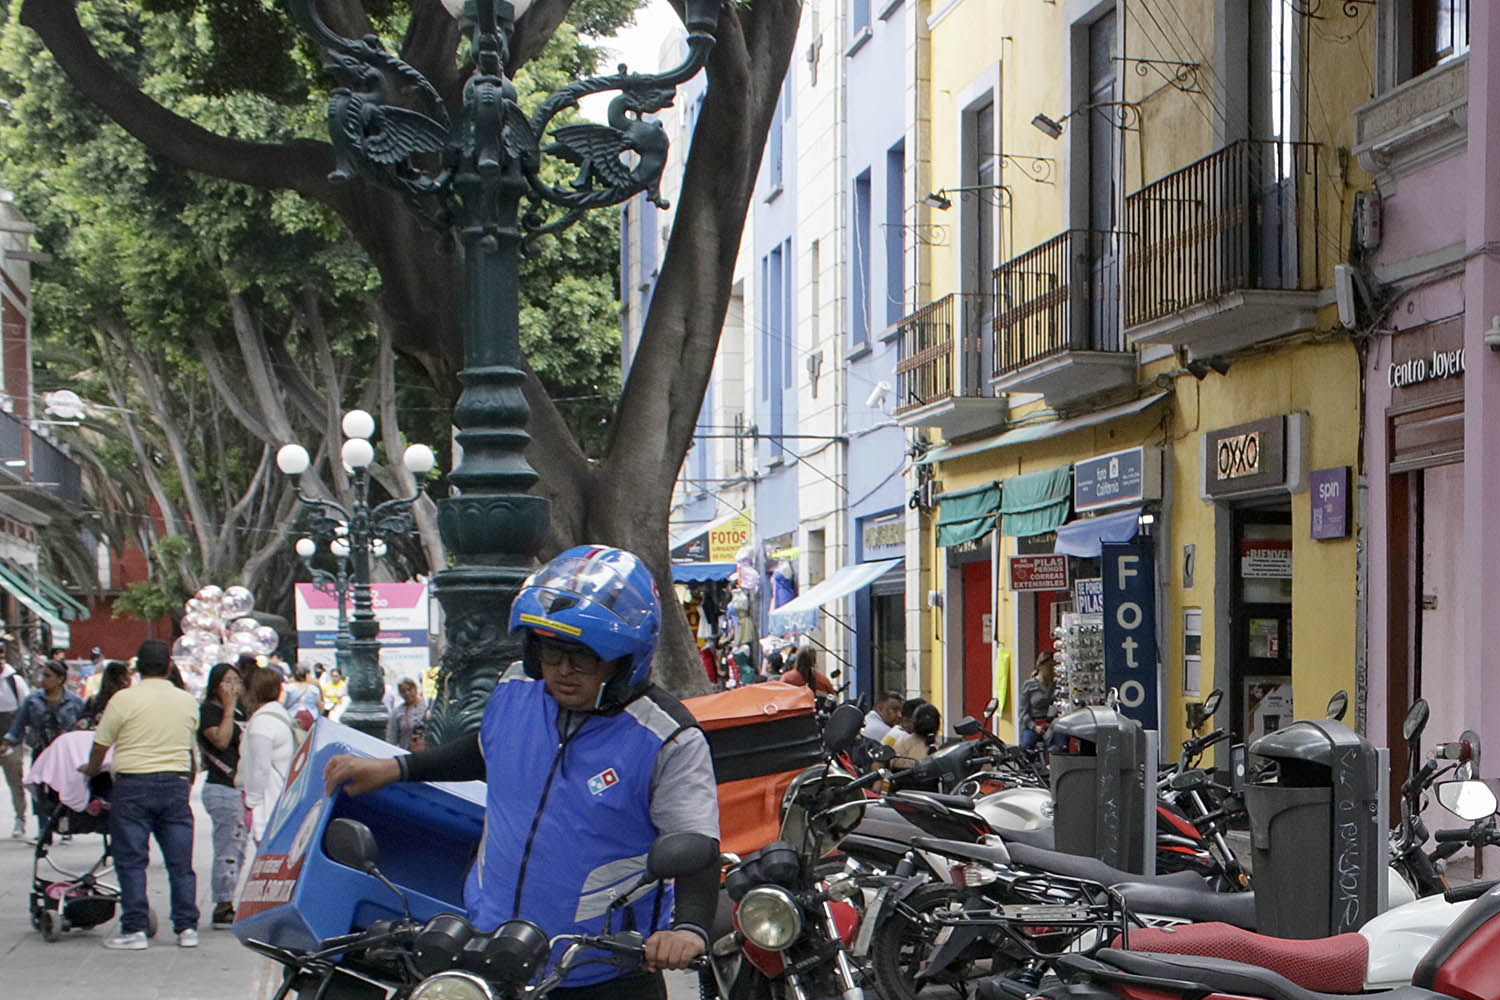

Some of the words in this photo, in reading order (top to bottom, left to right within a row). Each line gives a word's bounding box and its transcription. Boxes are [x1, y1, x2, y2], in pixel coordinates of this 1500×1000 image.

[1388, 358, 1425, 389] Centro
[1218, 435, 1258, 479] OXXO
[1319, 481, 1340, 501] spin
[711, 531, 746, 544] FOTOS
[1034, 558, 1064, 567] PILAS
[1014, 580, 1064, 588] EXTENSIBLES
[1077, 582, 1085, 594] SE
